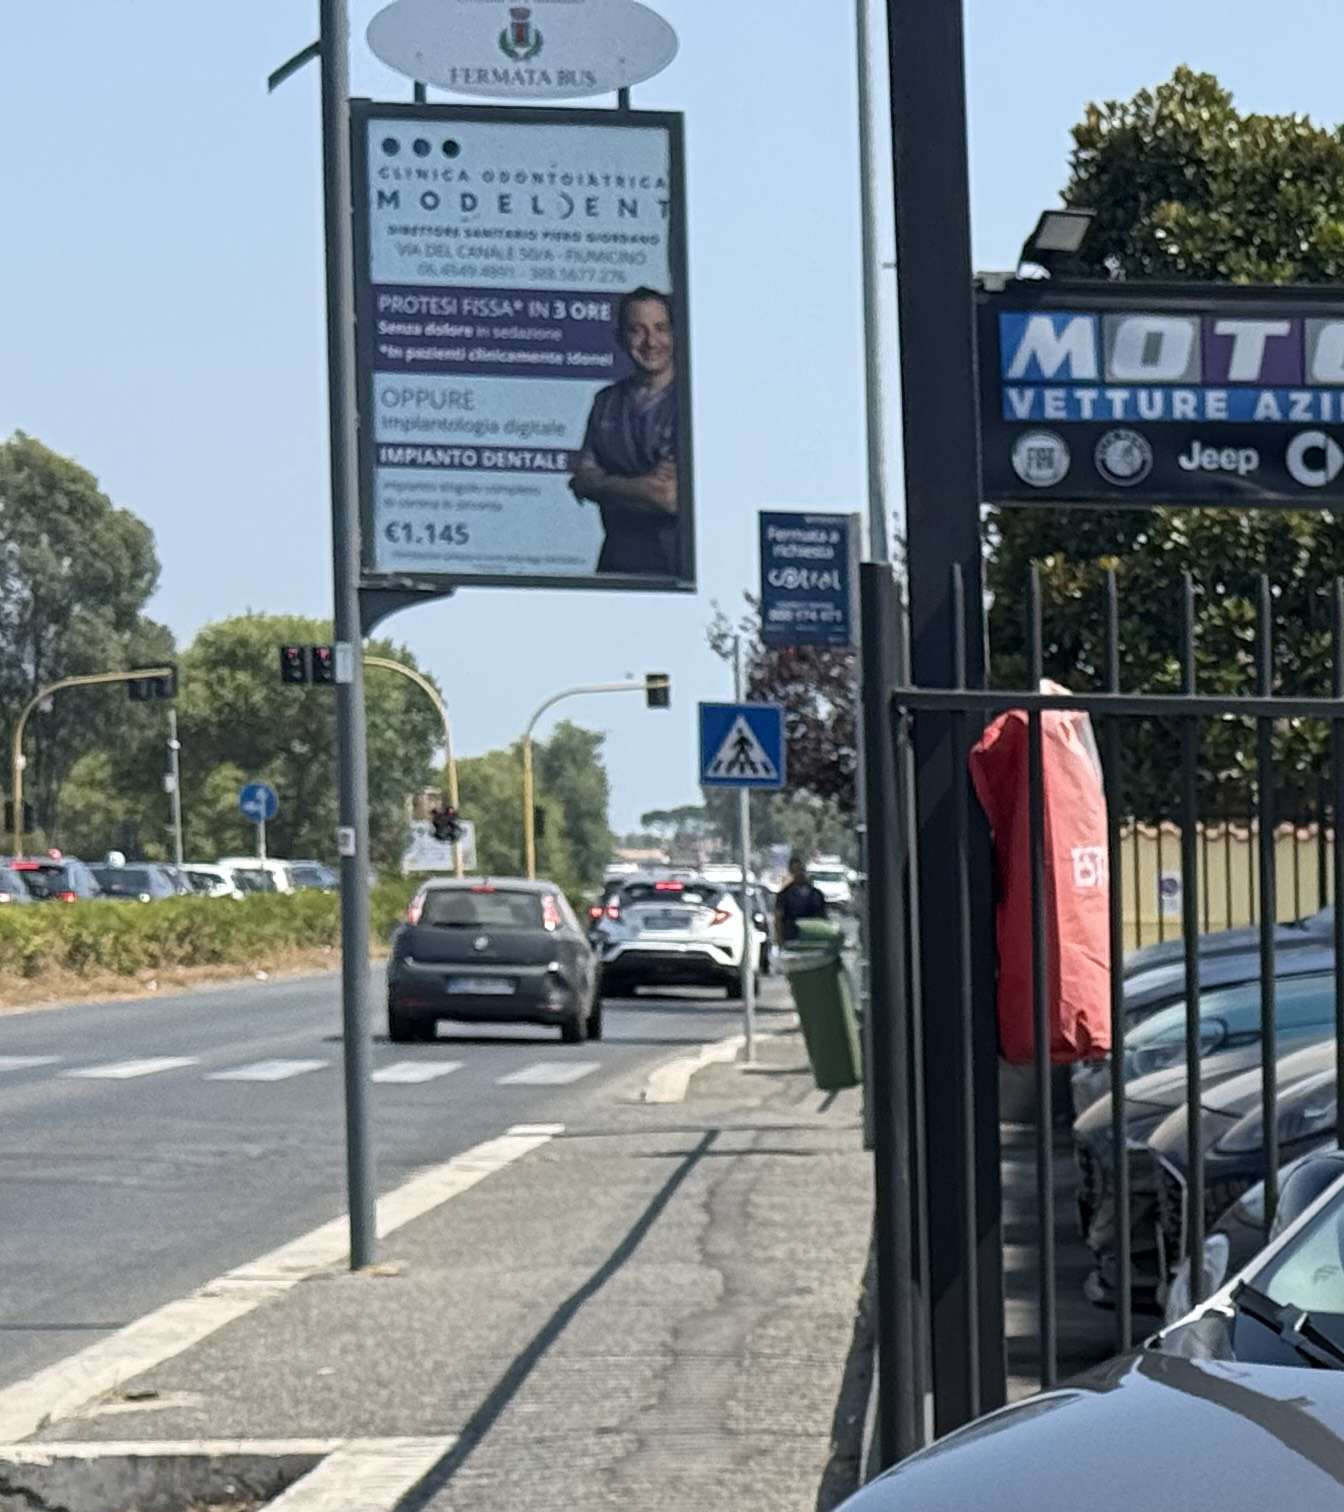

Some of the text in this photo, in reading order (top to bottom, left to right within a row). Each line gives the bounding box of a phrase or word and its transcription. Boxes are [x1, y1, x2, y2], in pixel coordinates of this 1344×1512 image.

[451, 67, 597, 88] FERMATA BUS
[377, 166, 469, 183] CLINICA
[386, 224, 459, 238] DIRETTORE
[463, 227, 537, 242] SANITARIO
[394, 241, 420, 257] VIA
[424, 243, 452, 259] DEL
[455, 245, 514, 261] CANALE
[564, 249, 647, 267] FIUMICINO
[378, 293, 458, 315] PROTESI
[527, 301, 550, 320] IN
[552, 302, 568, 321] 3
[569, 303, 612, 322] ORE
[377, 320, 563, 342] Senza dolore in sedazione
[405, 345, 467, 363] pazienti
[467, 348, 564, 366] clinicamente
[565, 350, 615, 367] idonei
[381, 388, 476, 411] OPPURE
[1005, 388, 1229, 421] VETTURE
[381, 414, 567, 439] Implantologia digitale
[379, 447, 568, 470] IMPIANTO DENTALE
[1177, 439, 1260, 476] Jeep
[384, 521, 470, 546] €1.145
